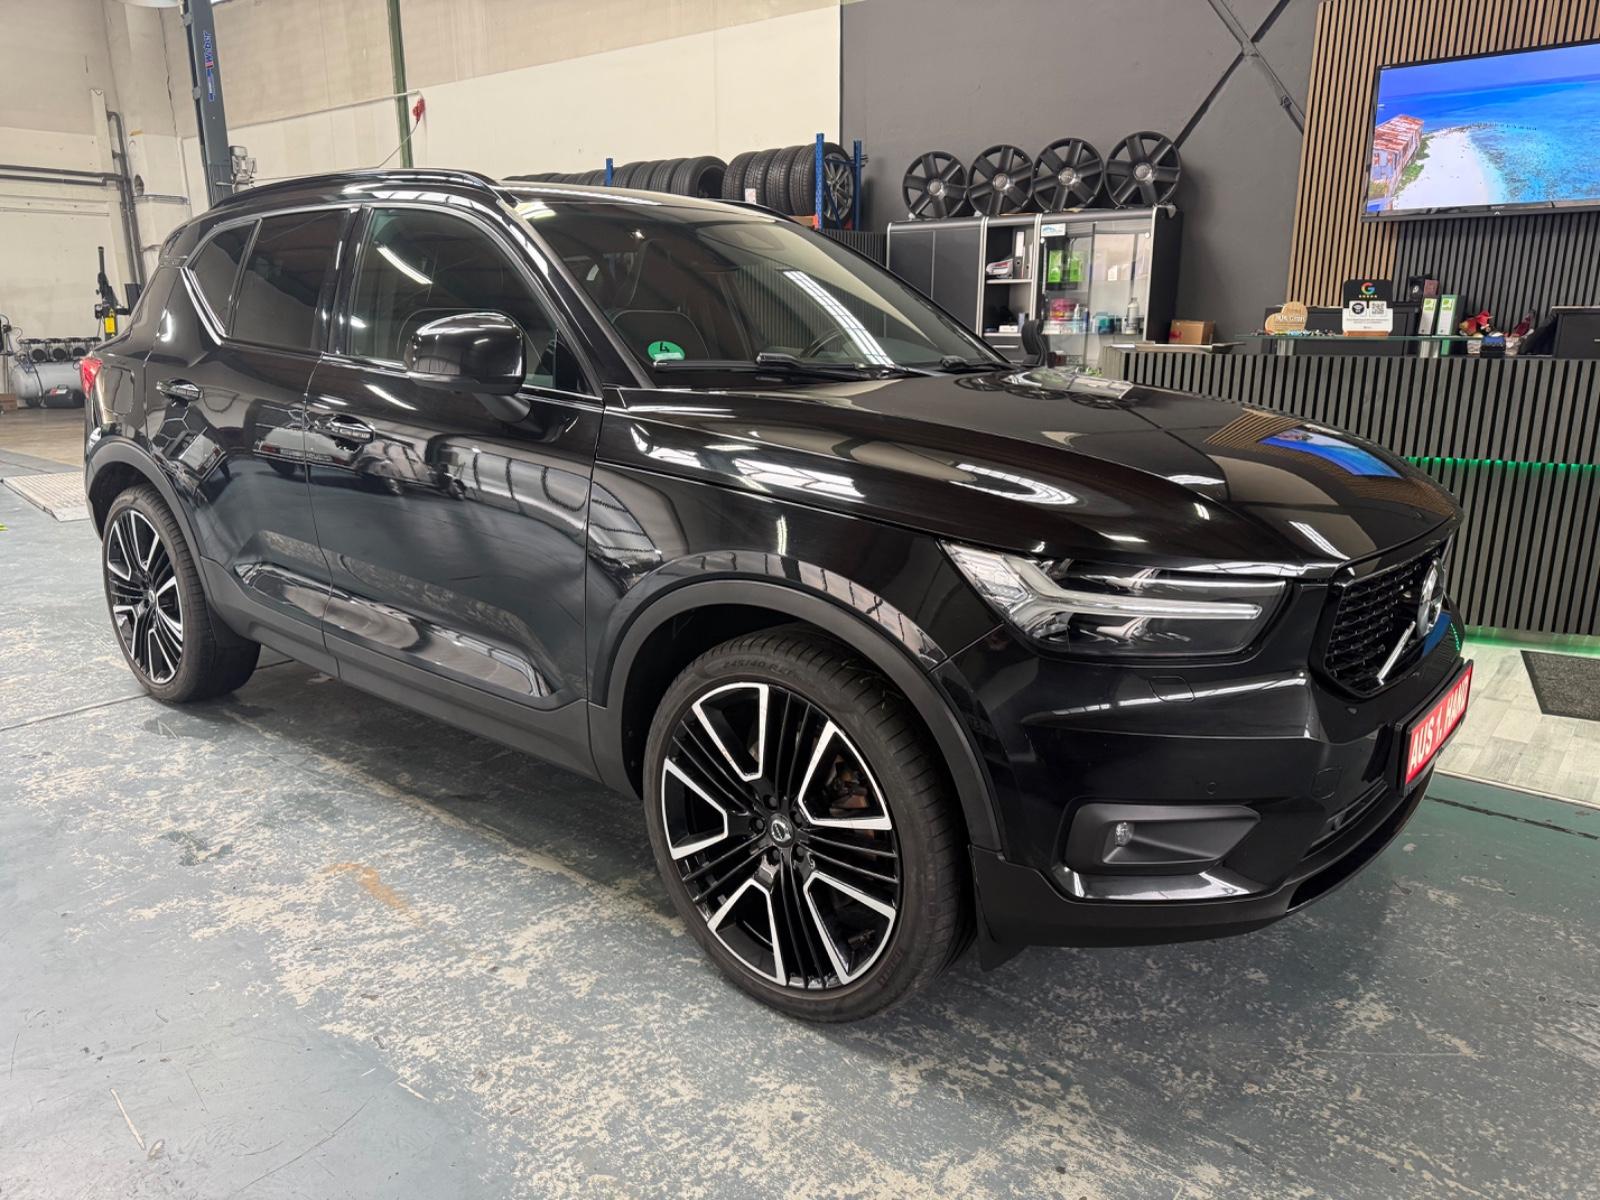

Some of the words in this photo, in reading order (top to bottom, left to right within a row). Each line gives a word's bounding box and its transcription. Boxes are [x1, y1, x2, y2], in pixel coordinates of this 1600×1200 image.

[1361, 282, 1376, 295] G
[659, 342, 670, 352] 4
[1409, 715, 1434, 772] AUS
[1435, 706, 1443, 742] 1.
